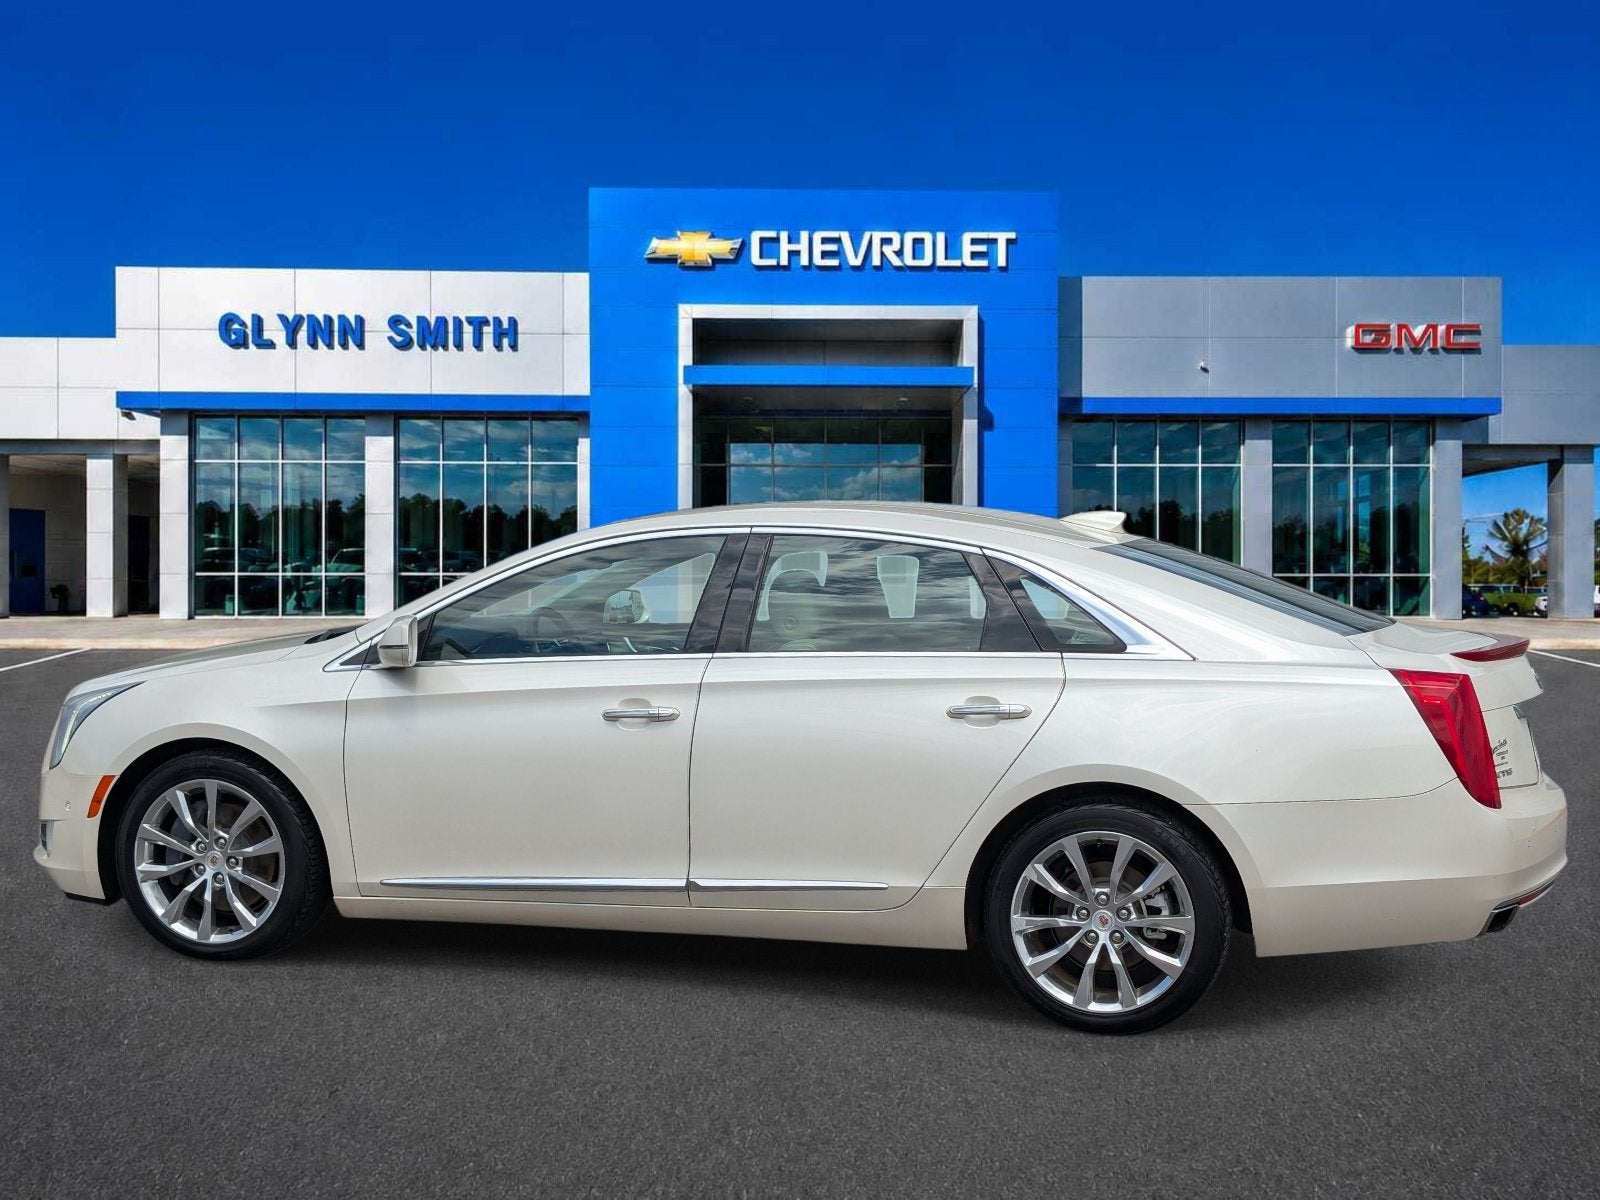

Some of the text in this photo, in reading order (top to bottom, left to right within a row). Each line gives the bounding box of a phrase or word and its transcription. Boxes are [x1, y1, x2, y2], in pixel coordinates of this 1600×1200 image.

[750, 229, 1017, 268] CHEVROLET
[218, 312, 520, 352] GLYNN SMITH
[1349, 322, 1482, 352] GMC
